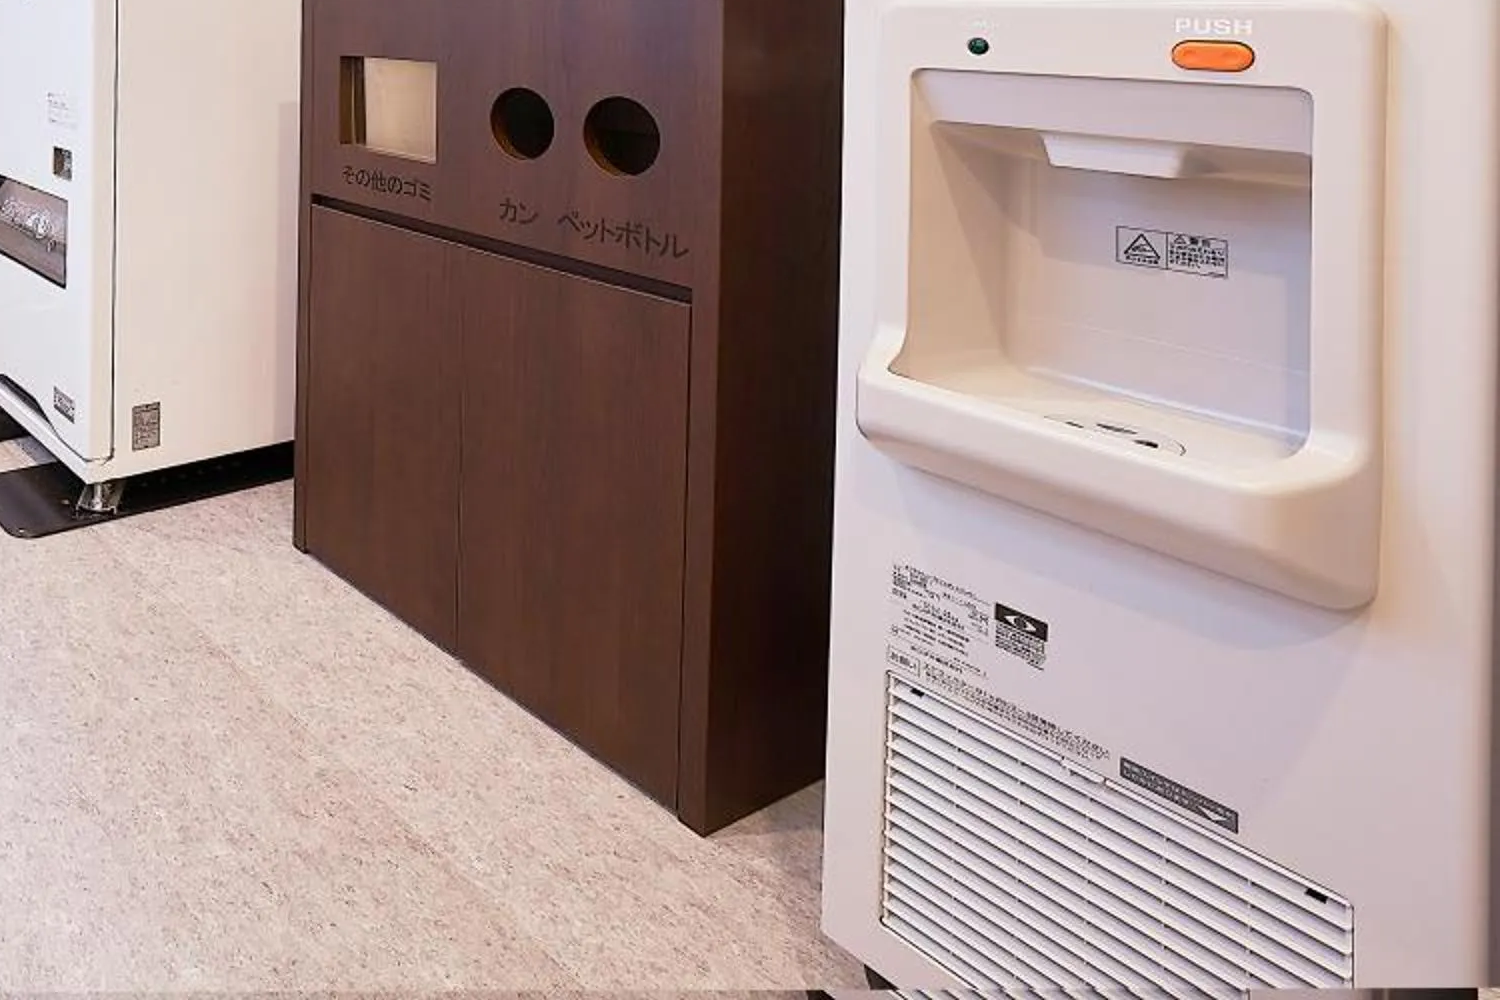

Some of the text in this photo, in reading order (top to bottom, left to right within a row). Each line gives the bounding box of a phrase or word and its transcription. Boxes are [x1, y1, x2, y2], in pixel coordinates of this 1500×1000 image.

[1175, 17, 1253, 35] PUSH
[342, 165, 433, 201] その他のゴミ
[499, 198, 538, 226] カン
[557, 210, 690, 259] ペットボトル
